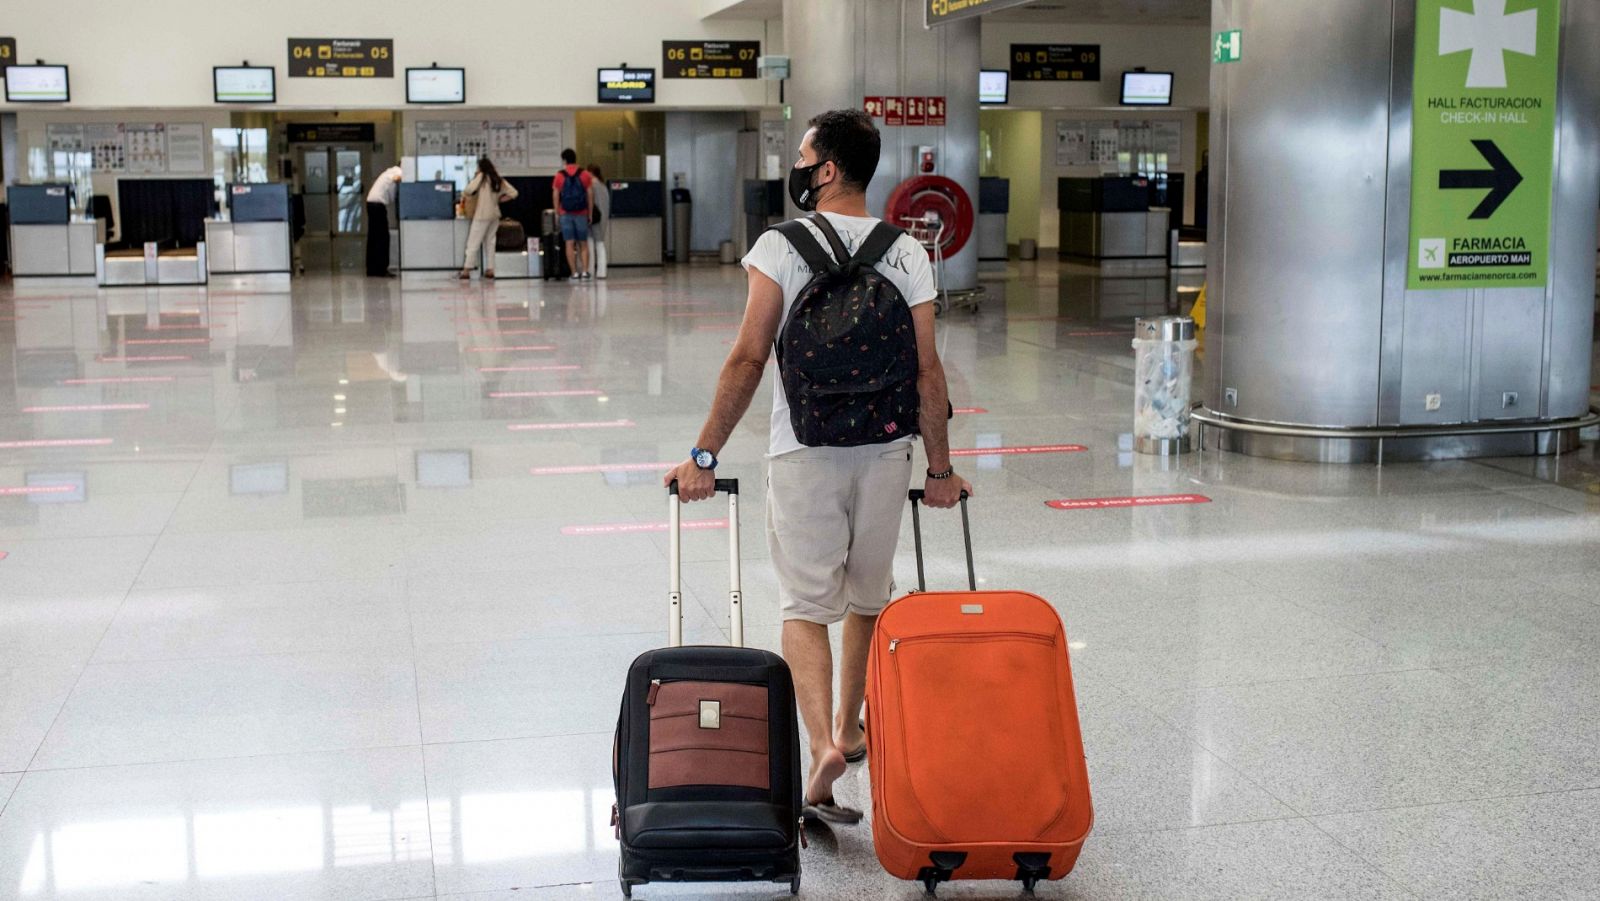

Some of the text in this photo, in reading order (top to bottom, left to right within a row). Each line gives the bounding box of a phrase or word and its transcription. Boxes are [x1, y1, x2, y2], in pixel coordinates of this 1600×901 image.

[0, 45, 10, 58] 3
[293, 46, 312, 59] 04
[370, 47, 388, 59] 05
[667, 48, 685, 60] 06
[739, 49, 755, 60] 07
[1015, 51, 1031, 62] 08
[1080, 52, 1096, 63] 09
[607, 81, 647, 89] MADRID
[1428, 97, 1542, 109] HALL FACTURACION
[1440, 111, 1528, 124] CHECK-IN HALL
[1453, 237, 1526, 251] FARMACIA
[1450, 254, 1530, 265] AEROPUERTO MAH
[1419, 271, 1537, 282] www.farmaciamenorca.com
